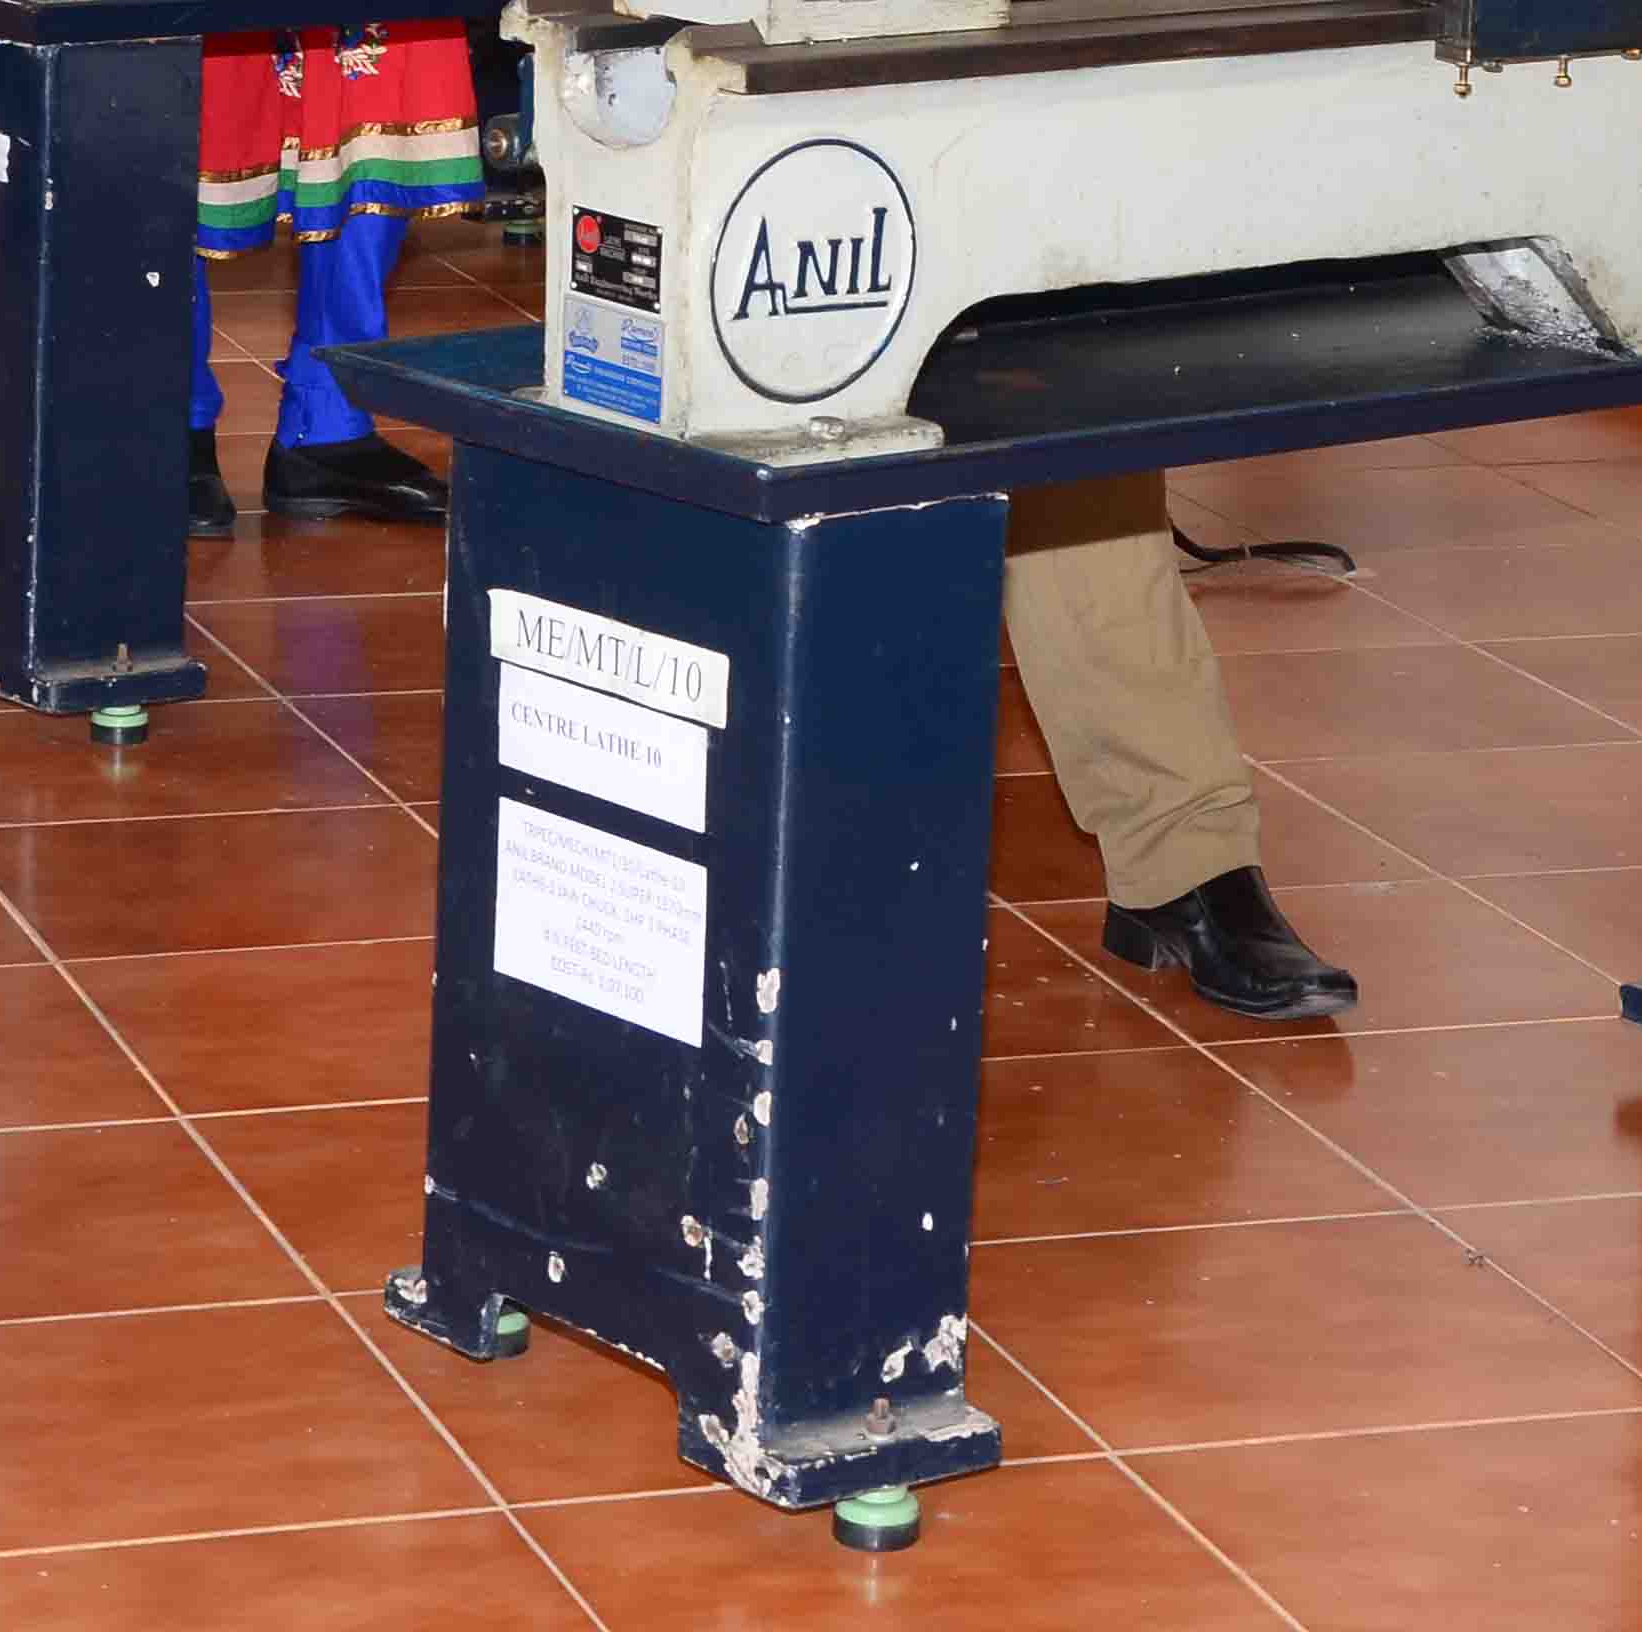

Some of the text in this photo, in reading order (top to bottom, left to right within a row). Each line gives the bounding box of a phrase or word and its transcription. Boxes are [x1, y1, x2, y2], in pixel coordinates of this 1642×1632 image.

[731, 206, 893, 320] ANIL
[517, 609, 702, 703] ME/MT/L/10
[511, 701, 579, 741] CENTRE
